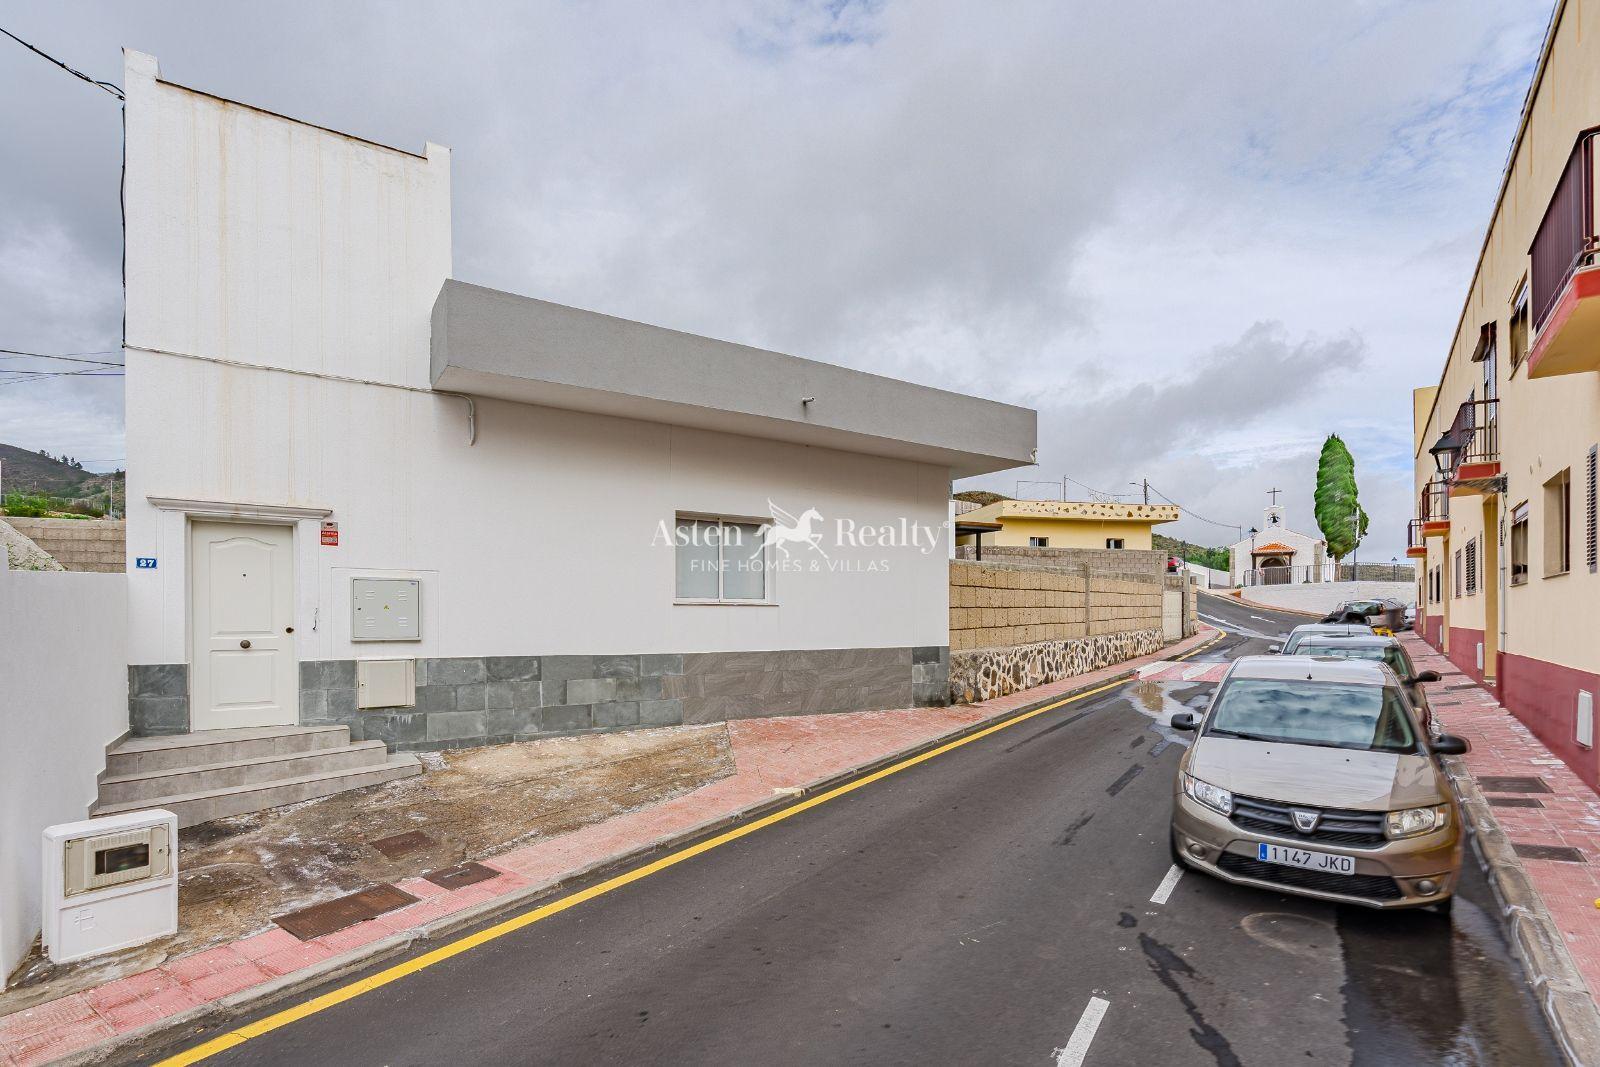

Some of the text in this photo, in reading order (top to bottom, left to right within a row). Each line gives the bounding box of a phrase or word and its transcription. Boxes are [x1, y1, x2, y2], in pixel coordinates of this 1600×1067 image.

[139, 559, 155, 568] 27
[1272, 847, 1351, 872] 1147 JKD
